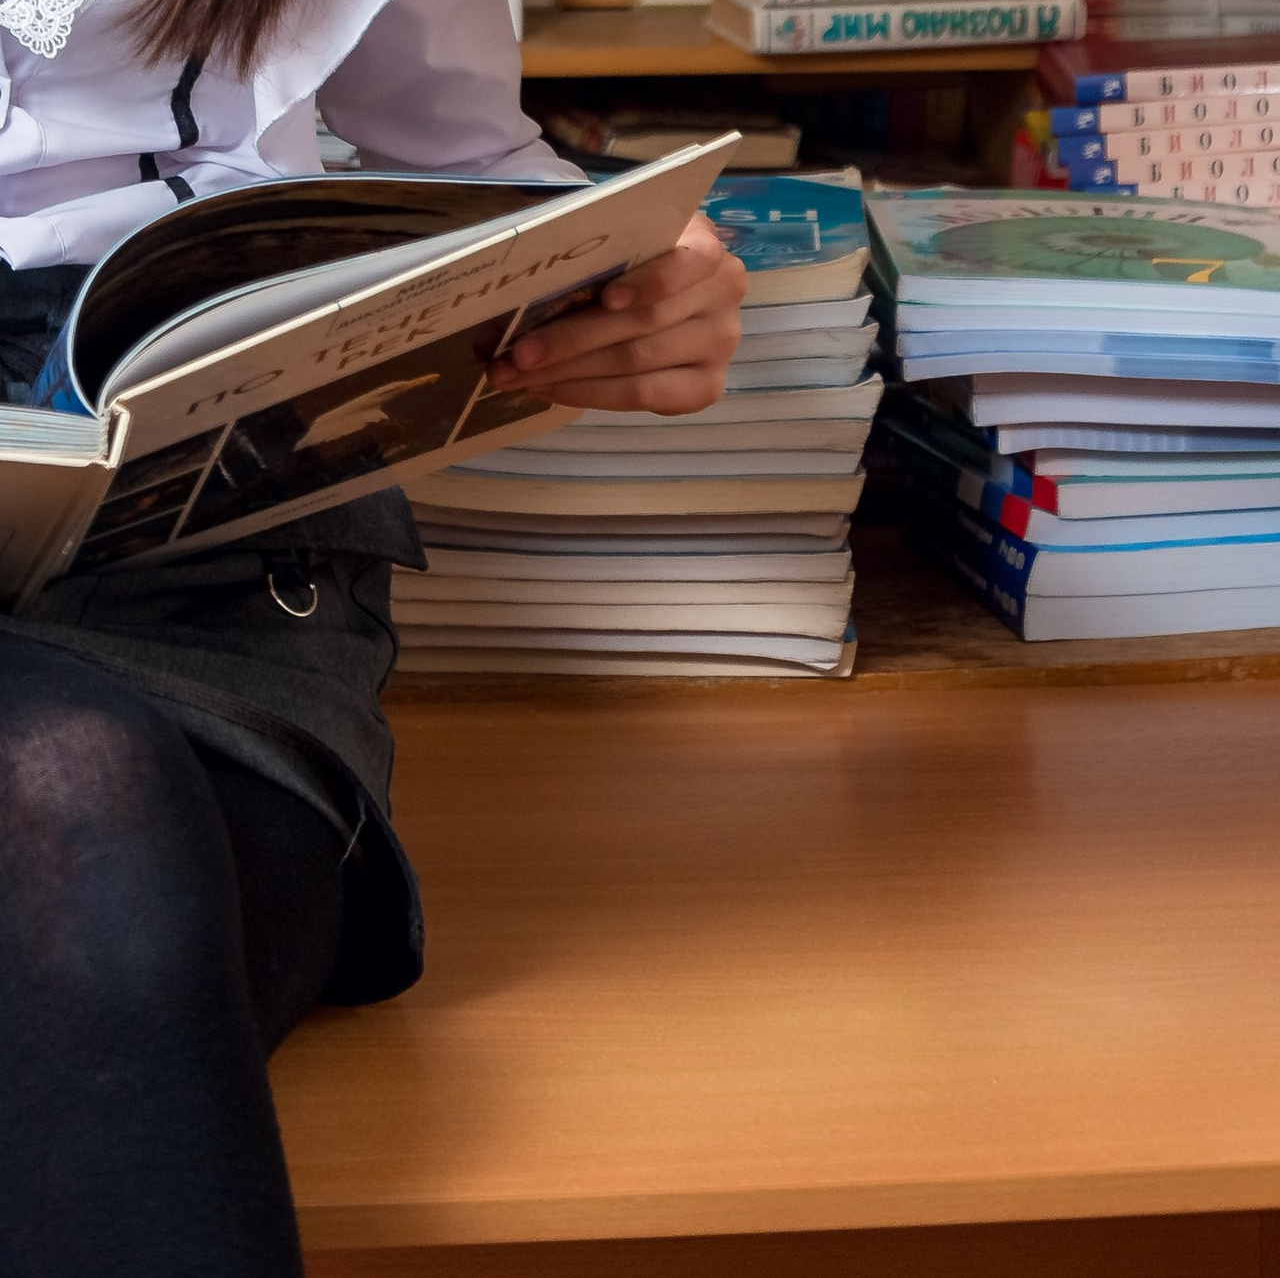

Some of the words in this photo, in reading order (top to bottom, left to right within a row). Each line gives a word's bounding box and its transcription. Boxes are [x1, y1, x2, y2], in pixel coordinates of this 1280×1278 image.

[822, 12, 890, 43] МИР
[901, 7, 1029, 40] ПОЗНАЮ
[1037, 5, 1061, 38] Я
[1151, 256, 1224, 283] 7
[185, 369, 284, 416] ПО
[310, 234, 610, 365] ТЕЧЕНИЮ
[336, 325, 437, 370] РЕК
